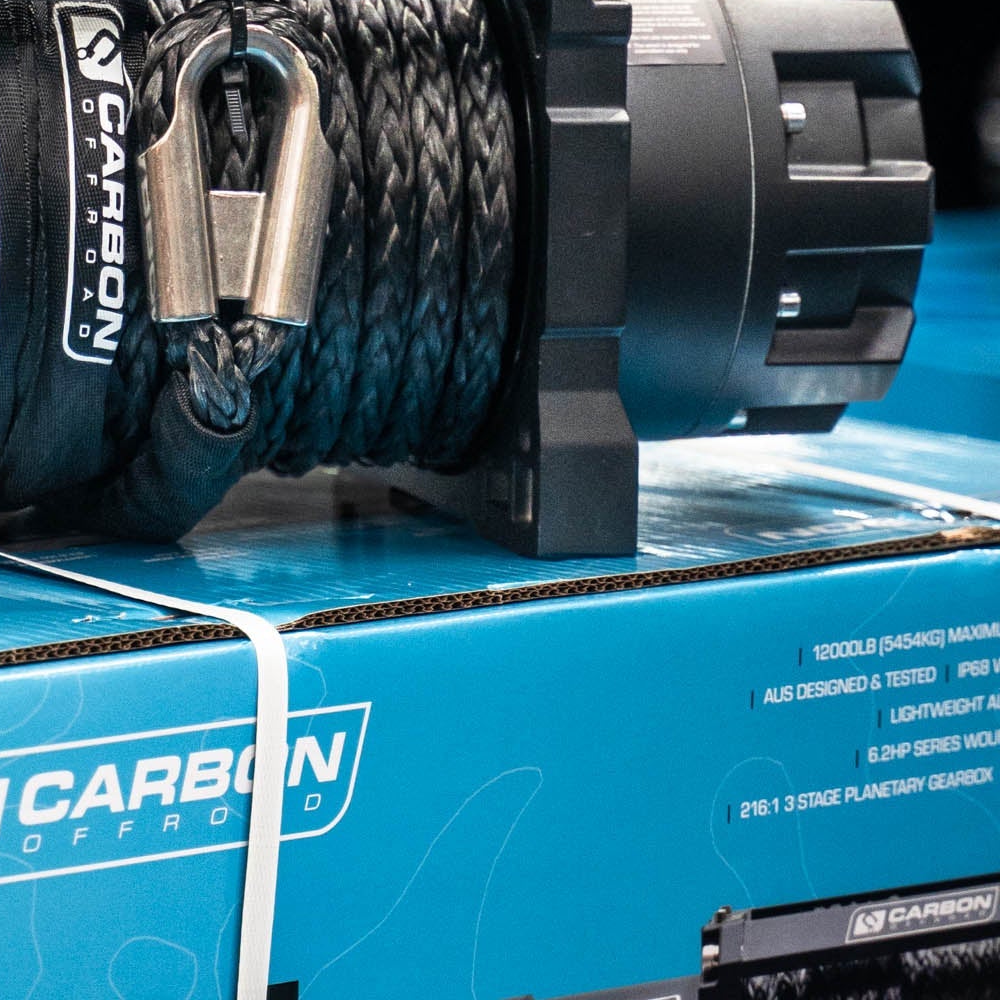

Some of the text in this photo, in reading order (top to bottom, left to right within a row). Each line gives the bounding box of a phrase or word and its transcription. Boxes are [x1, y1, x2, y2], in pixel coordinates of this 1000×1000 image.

[79, 99, 98, 337] OFFROAD
[93, 92, 126, 351] CARBON
[812, 638, 877, 661] 12000LB
[763, 666, 937, 705] AUS DESIGNED & TESTED
[957, 659, 990, 678] IP68
[890, 695, 985, 724] LIGHTWEIGHT
[868, 742, 911, 764] 6.2HP
[913, 735, 961, 757] SERIES
[740, 766, 994, 819] 216:1 3 STAGE PLANETARY GEARBOX
[22, 793, 321, 853] OFFROD
[888, 894, 993, 923] CARBON
